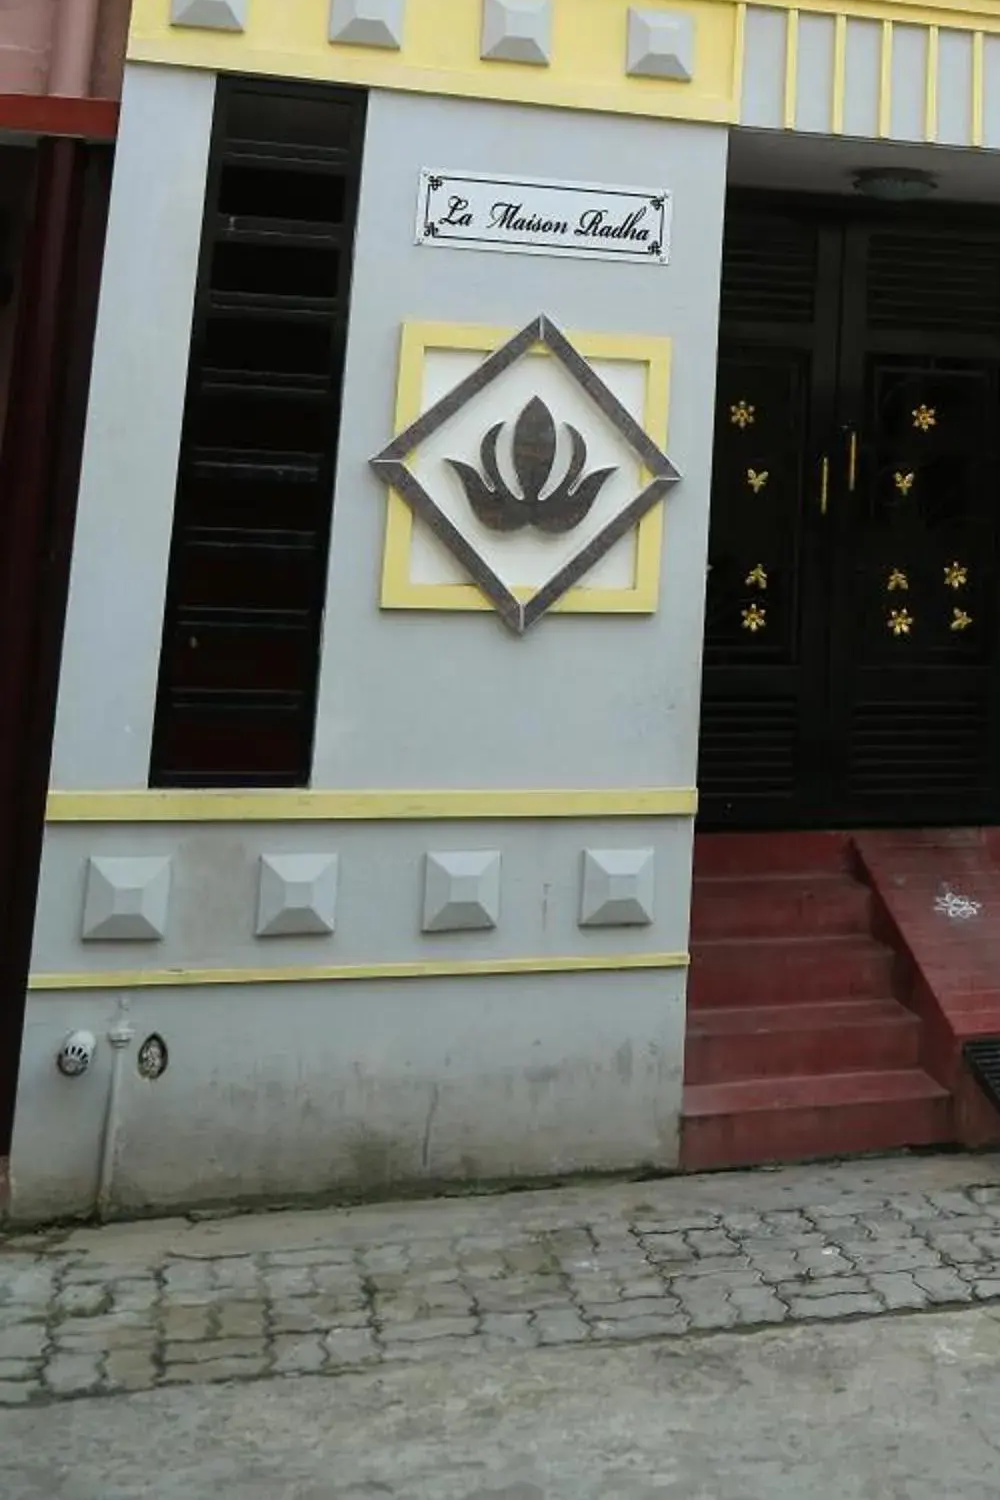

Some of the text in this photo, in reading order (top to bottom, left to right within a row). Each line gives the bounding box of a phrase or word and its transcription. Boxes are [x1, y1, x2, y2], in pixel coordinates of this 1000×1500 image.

[438, 195, 650, 242] La Maison Radha
